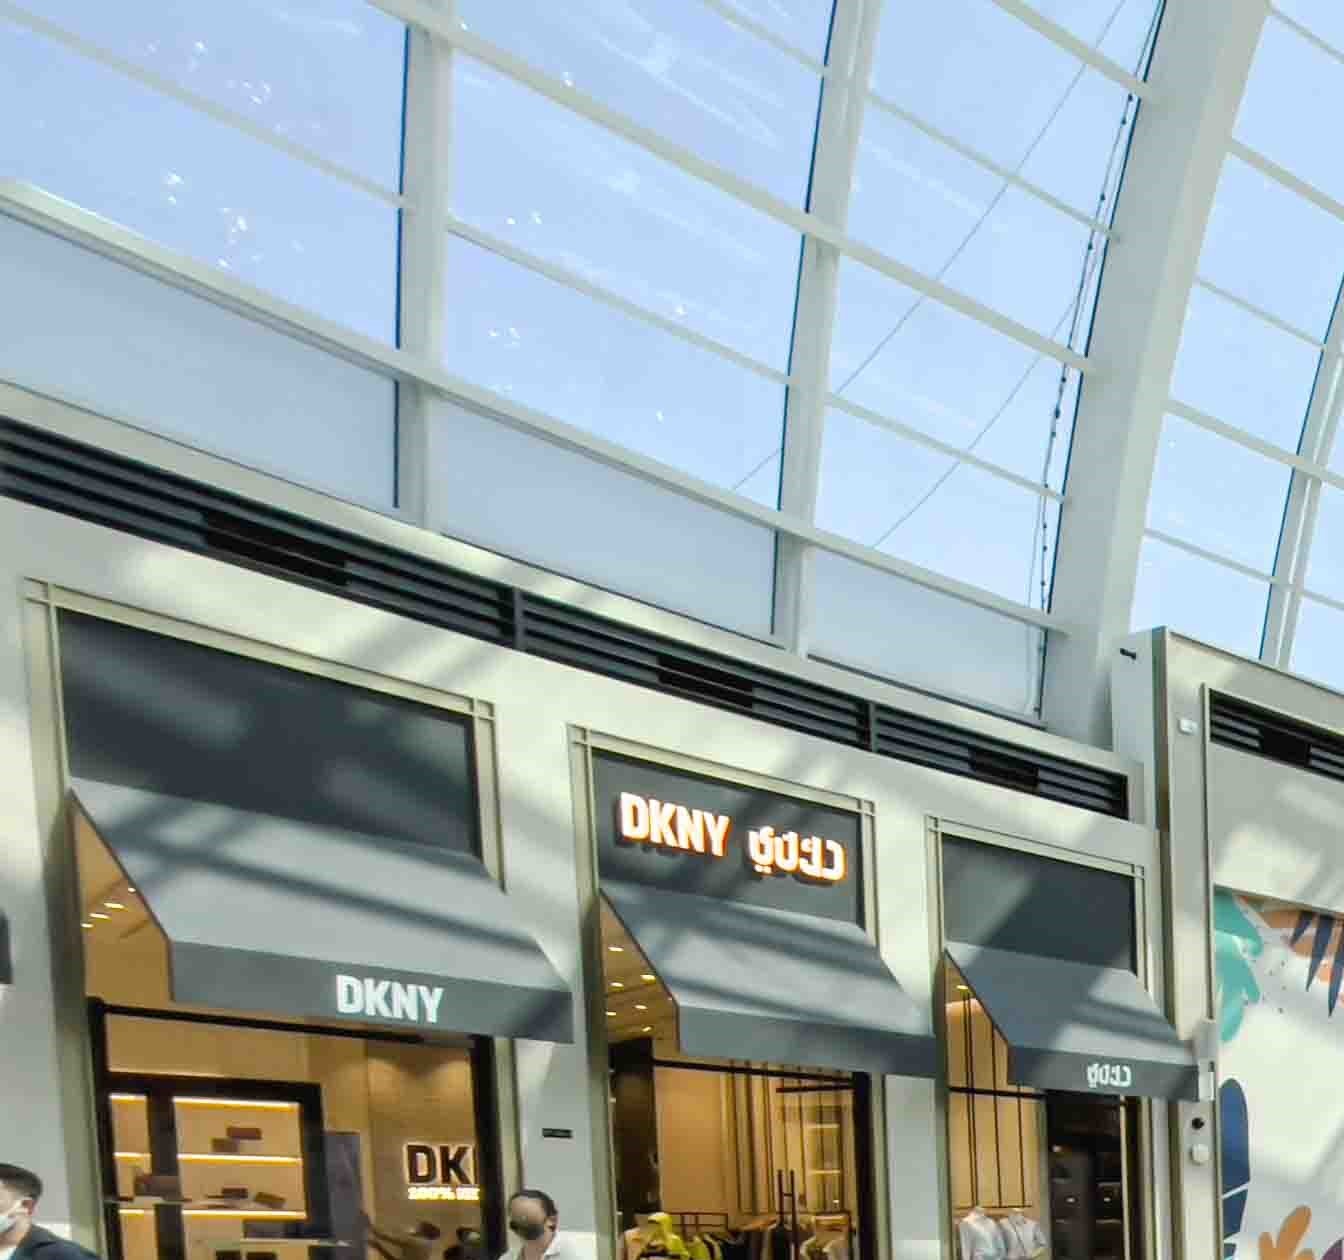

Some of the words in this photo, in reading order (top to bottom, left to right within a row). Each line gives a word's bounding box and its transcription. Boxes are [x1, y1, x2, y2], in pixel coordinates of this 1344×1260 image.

[620, 791, 731, 858] DKNY
[336, 974, 444, 1023] DKNY
[405, 1143, 479, 1185] DK
